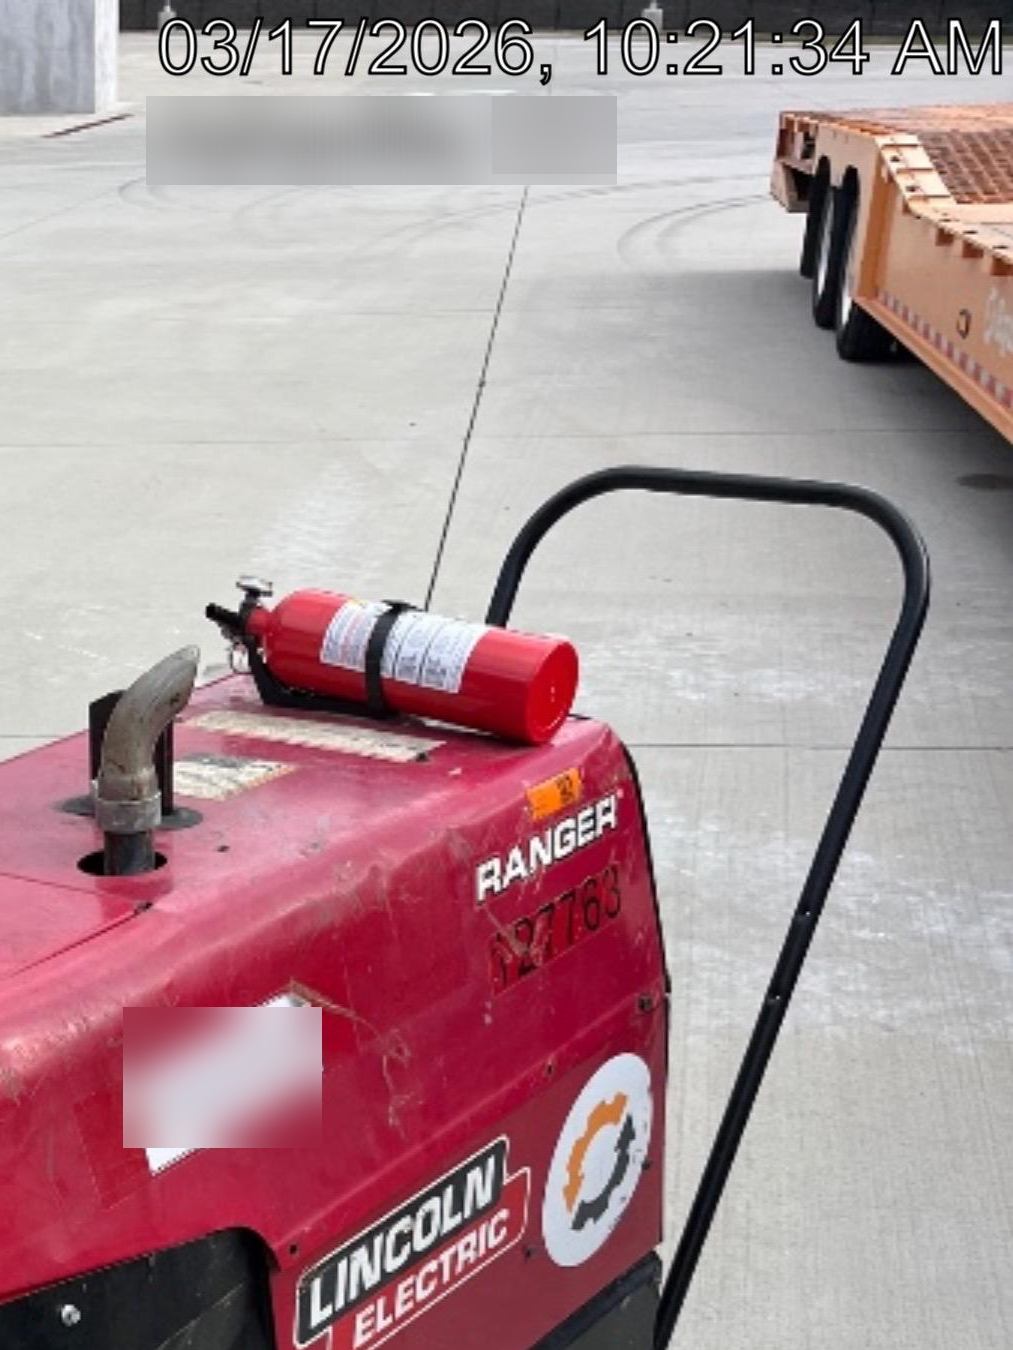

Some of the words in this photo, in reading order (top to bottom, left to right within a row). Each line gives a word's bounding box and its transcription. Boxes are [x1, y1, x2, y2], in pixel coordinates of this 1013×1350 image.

[475, 795, 617, 904] RANGER
[310, 1154, 496, 1329] LINCOLN
[352, 1208, 510, 1350] ELECTRIC
